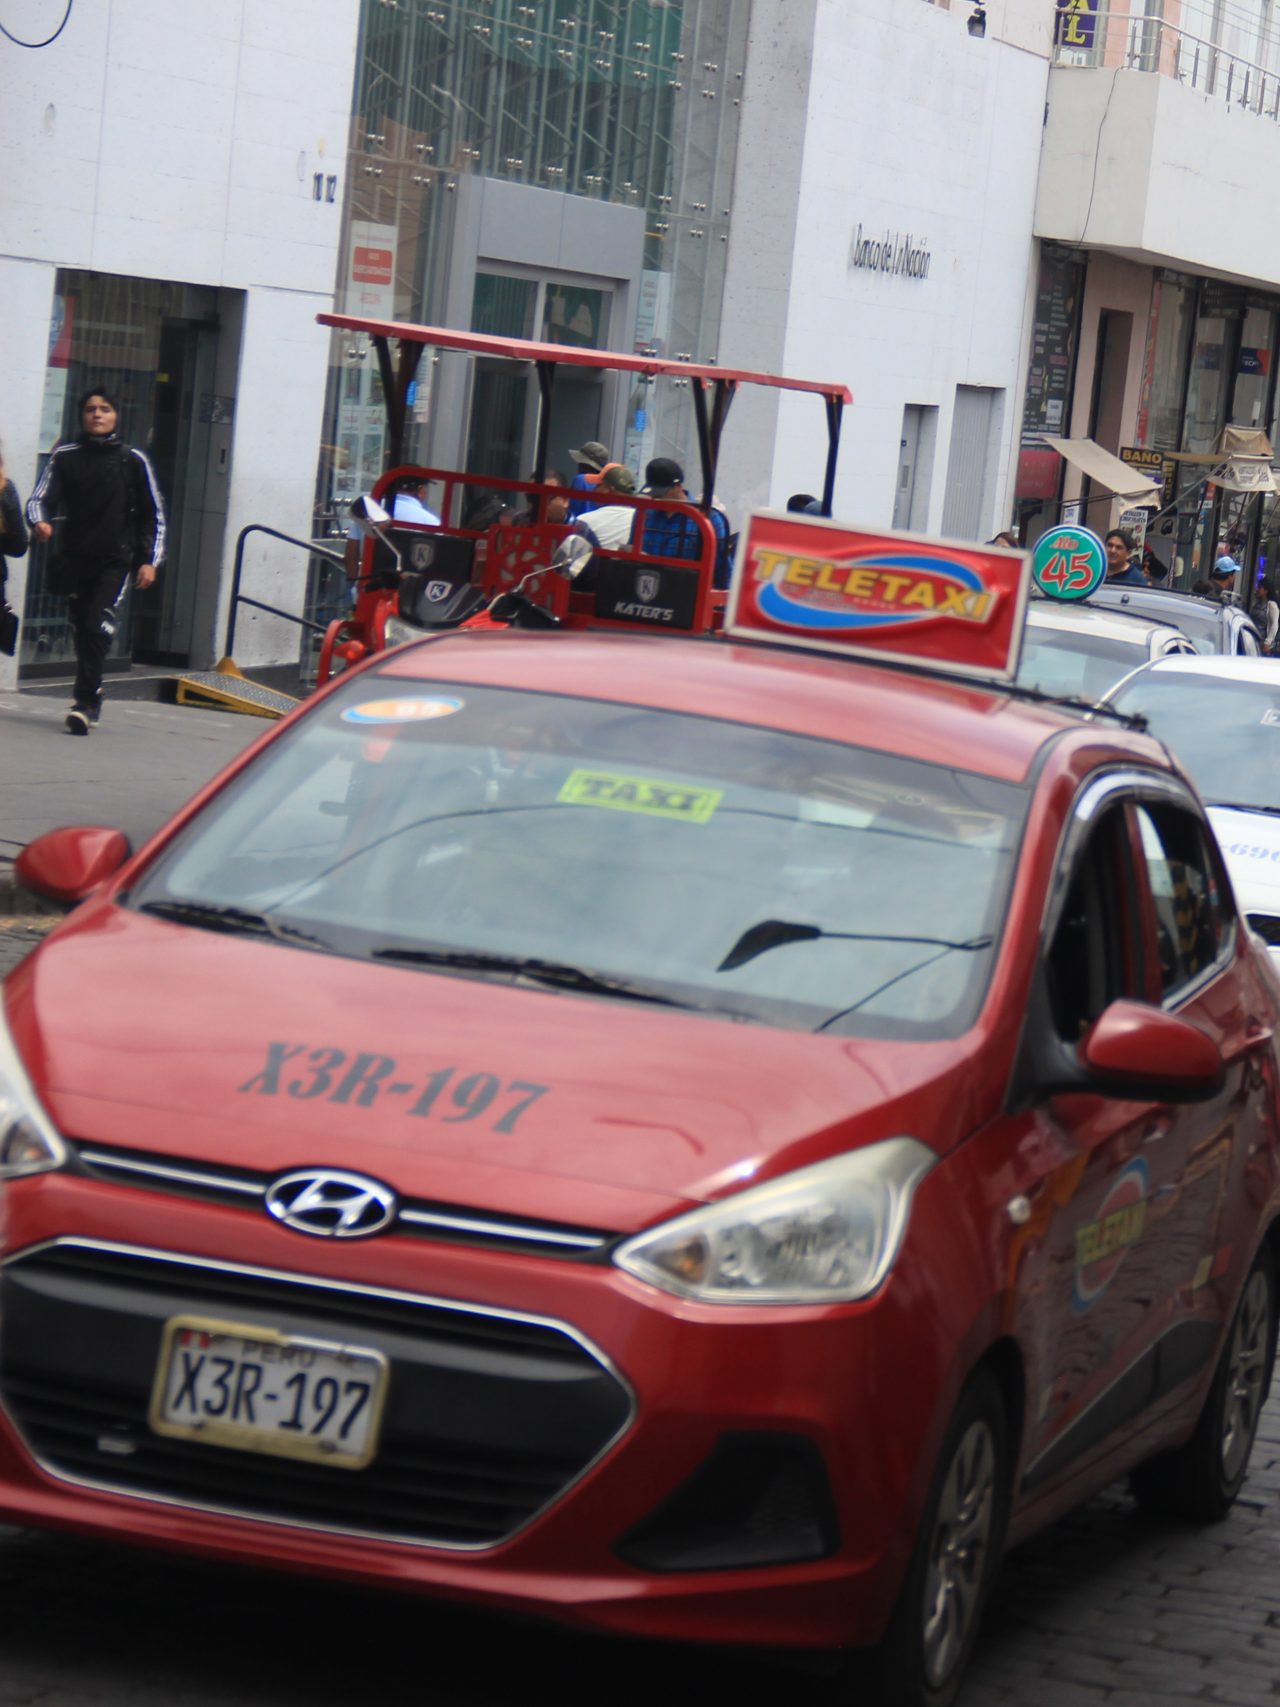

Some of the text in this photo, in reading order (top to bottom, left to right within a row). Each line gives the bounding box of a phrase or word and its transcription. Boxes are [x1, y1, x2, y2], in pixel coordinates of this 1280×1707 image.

[755, 551, 991, 620] TELETAXI
[1041, 550, 1094, 593] 45
[613, 601, 674, 621] KATER'S
[580, 778, 700, 811] TAXI
[237, 1041, 551, 1135] X3R-197
[173, 1352, 371, 1440] X3R-197
